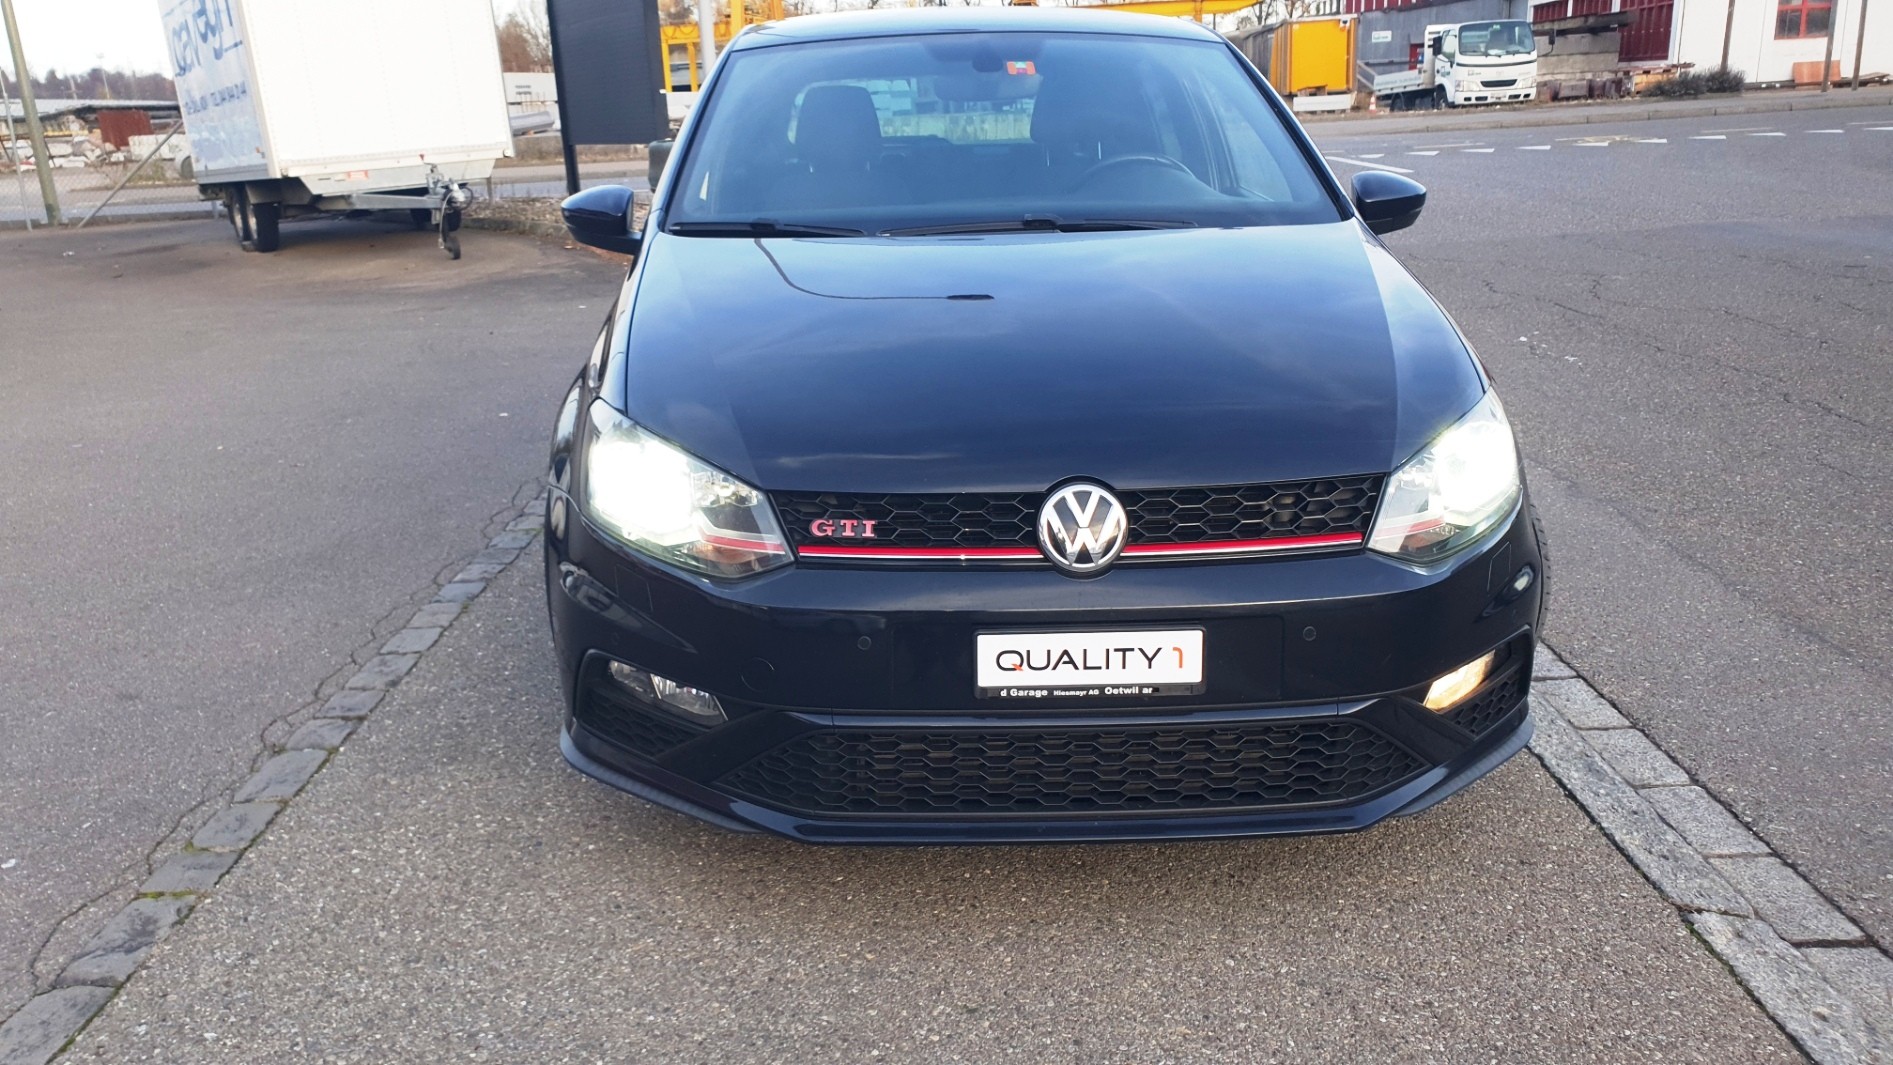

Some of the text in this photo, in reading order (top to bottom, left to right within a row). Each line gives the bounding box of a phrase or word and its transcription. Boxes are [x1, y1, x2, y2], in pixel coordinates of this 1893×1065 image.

[811, 519, 877, 537] GTI
[996, 647, 1162, 672] QUALITY
[1010, 688, 1048, 698] Garage
[1104, 686, 1139, 694] Oetwil
